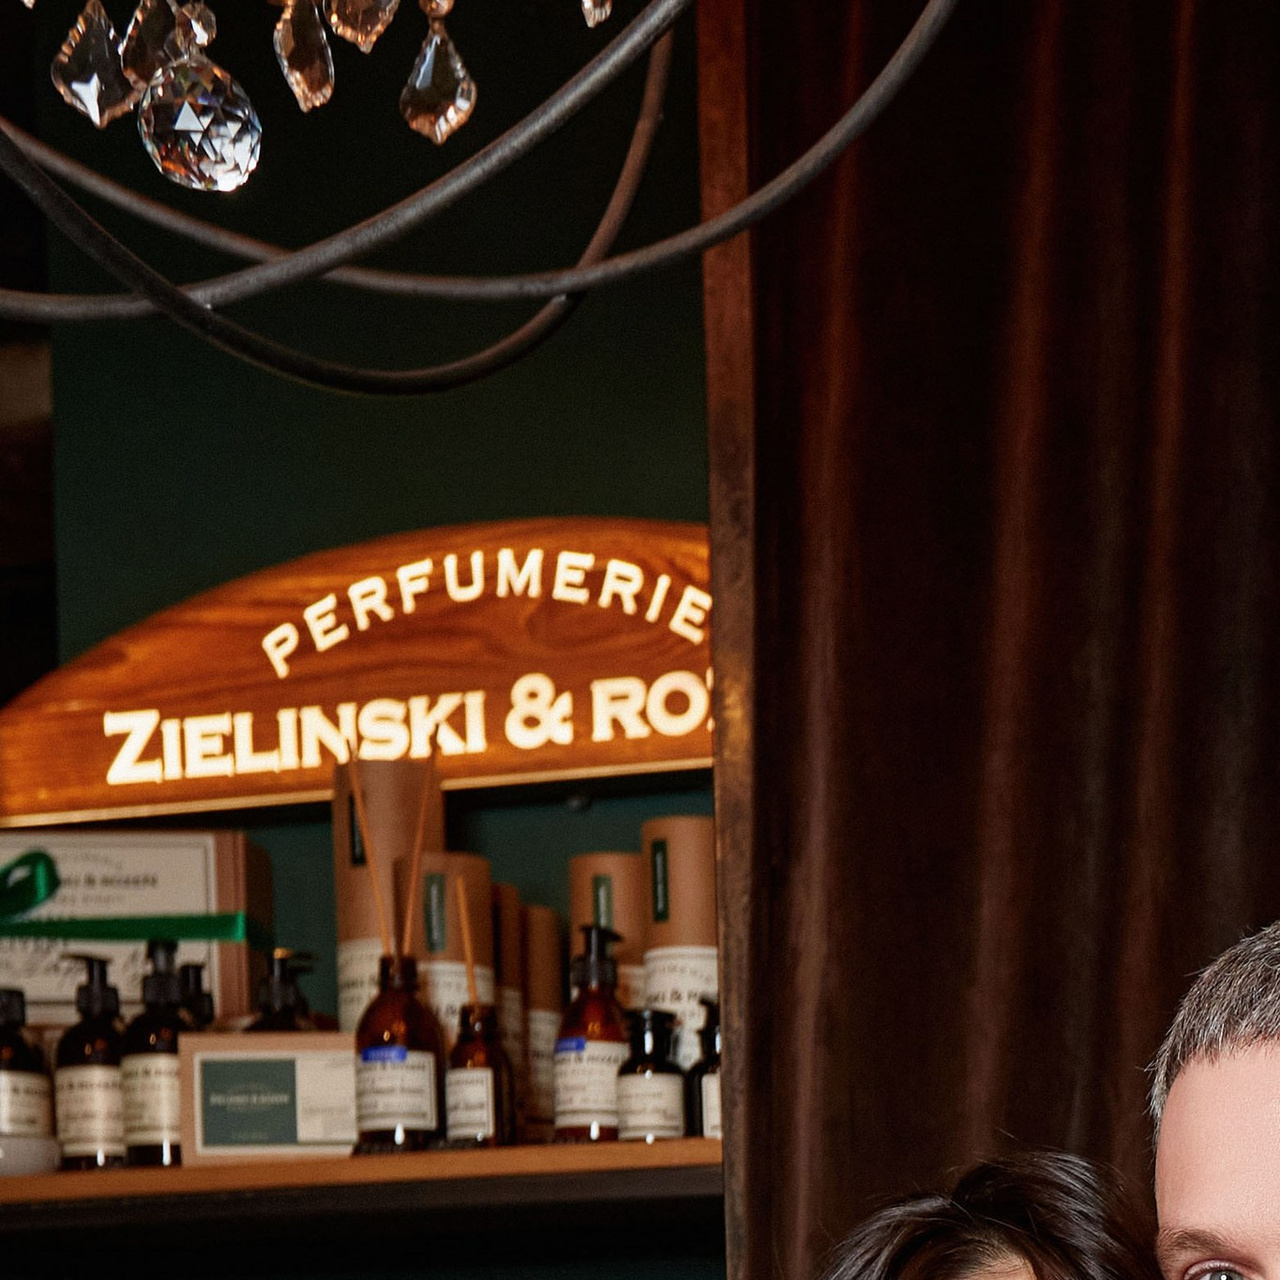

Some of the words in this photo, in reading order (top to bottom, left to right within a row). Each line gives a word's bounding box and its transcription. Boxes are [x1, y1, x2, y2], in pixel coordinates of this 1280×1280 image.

[261, 547, 712, 678] PERFUMERIE
[103, 690, 488, 785] ZIELINSKI
[505, 673, 574, 750] &
[590, 669, 714, 743] RO
